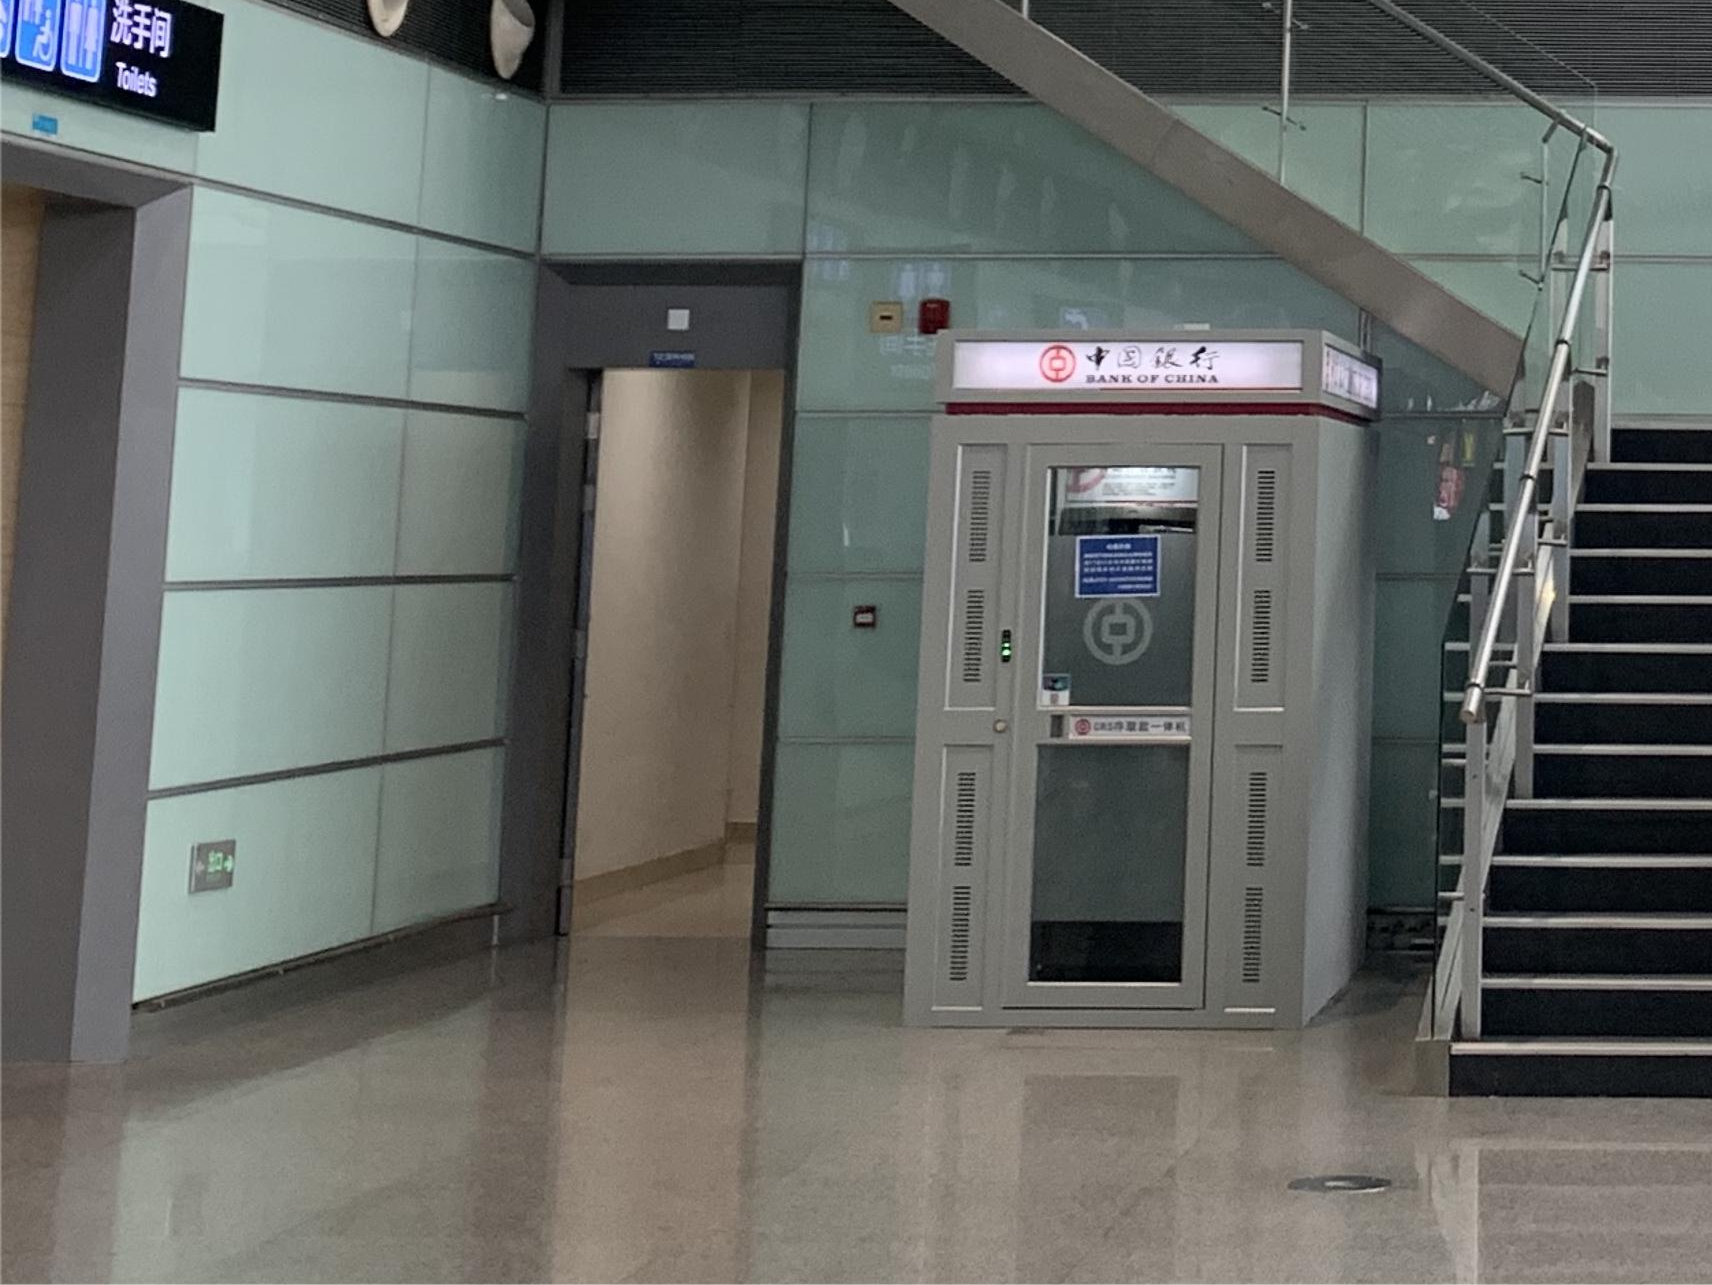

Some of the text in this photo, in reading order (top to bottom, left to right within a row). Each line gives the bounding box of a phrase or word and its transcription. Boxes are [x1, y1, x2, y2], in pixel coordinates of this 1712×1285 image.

[115, 62, 157, 97] Toilets
[1086, 373, 1219, 384] BANK OF CHINA
